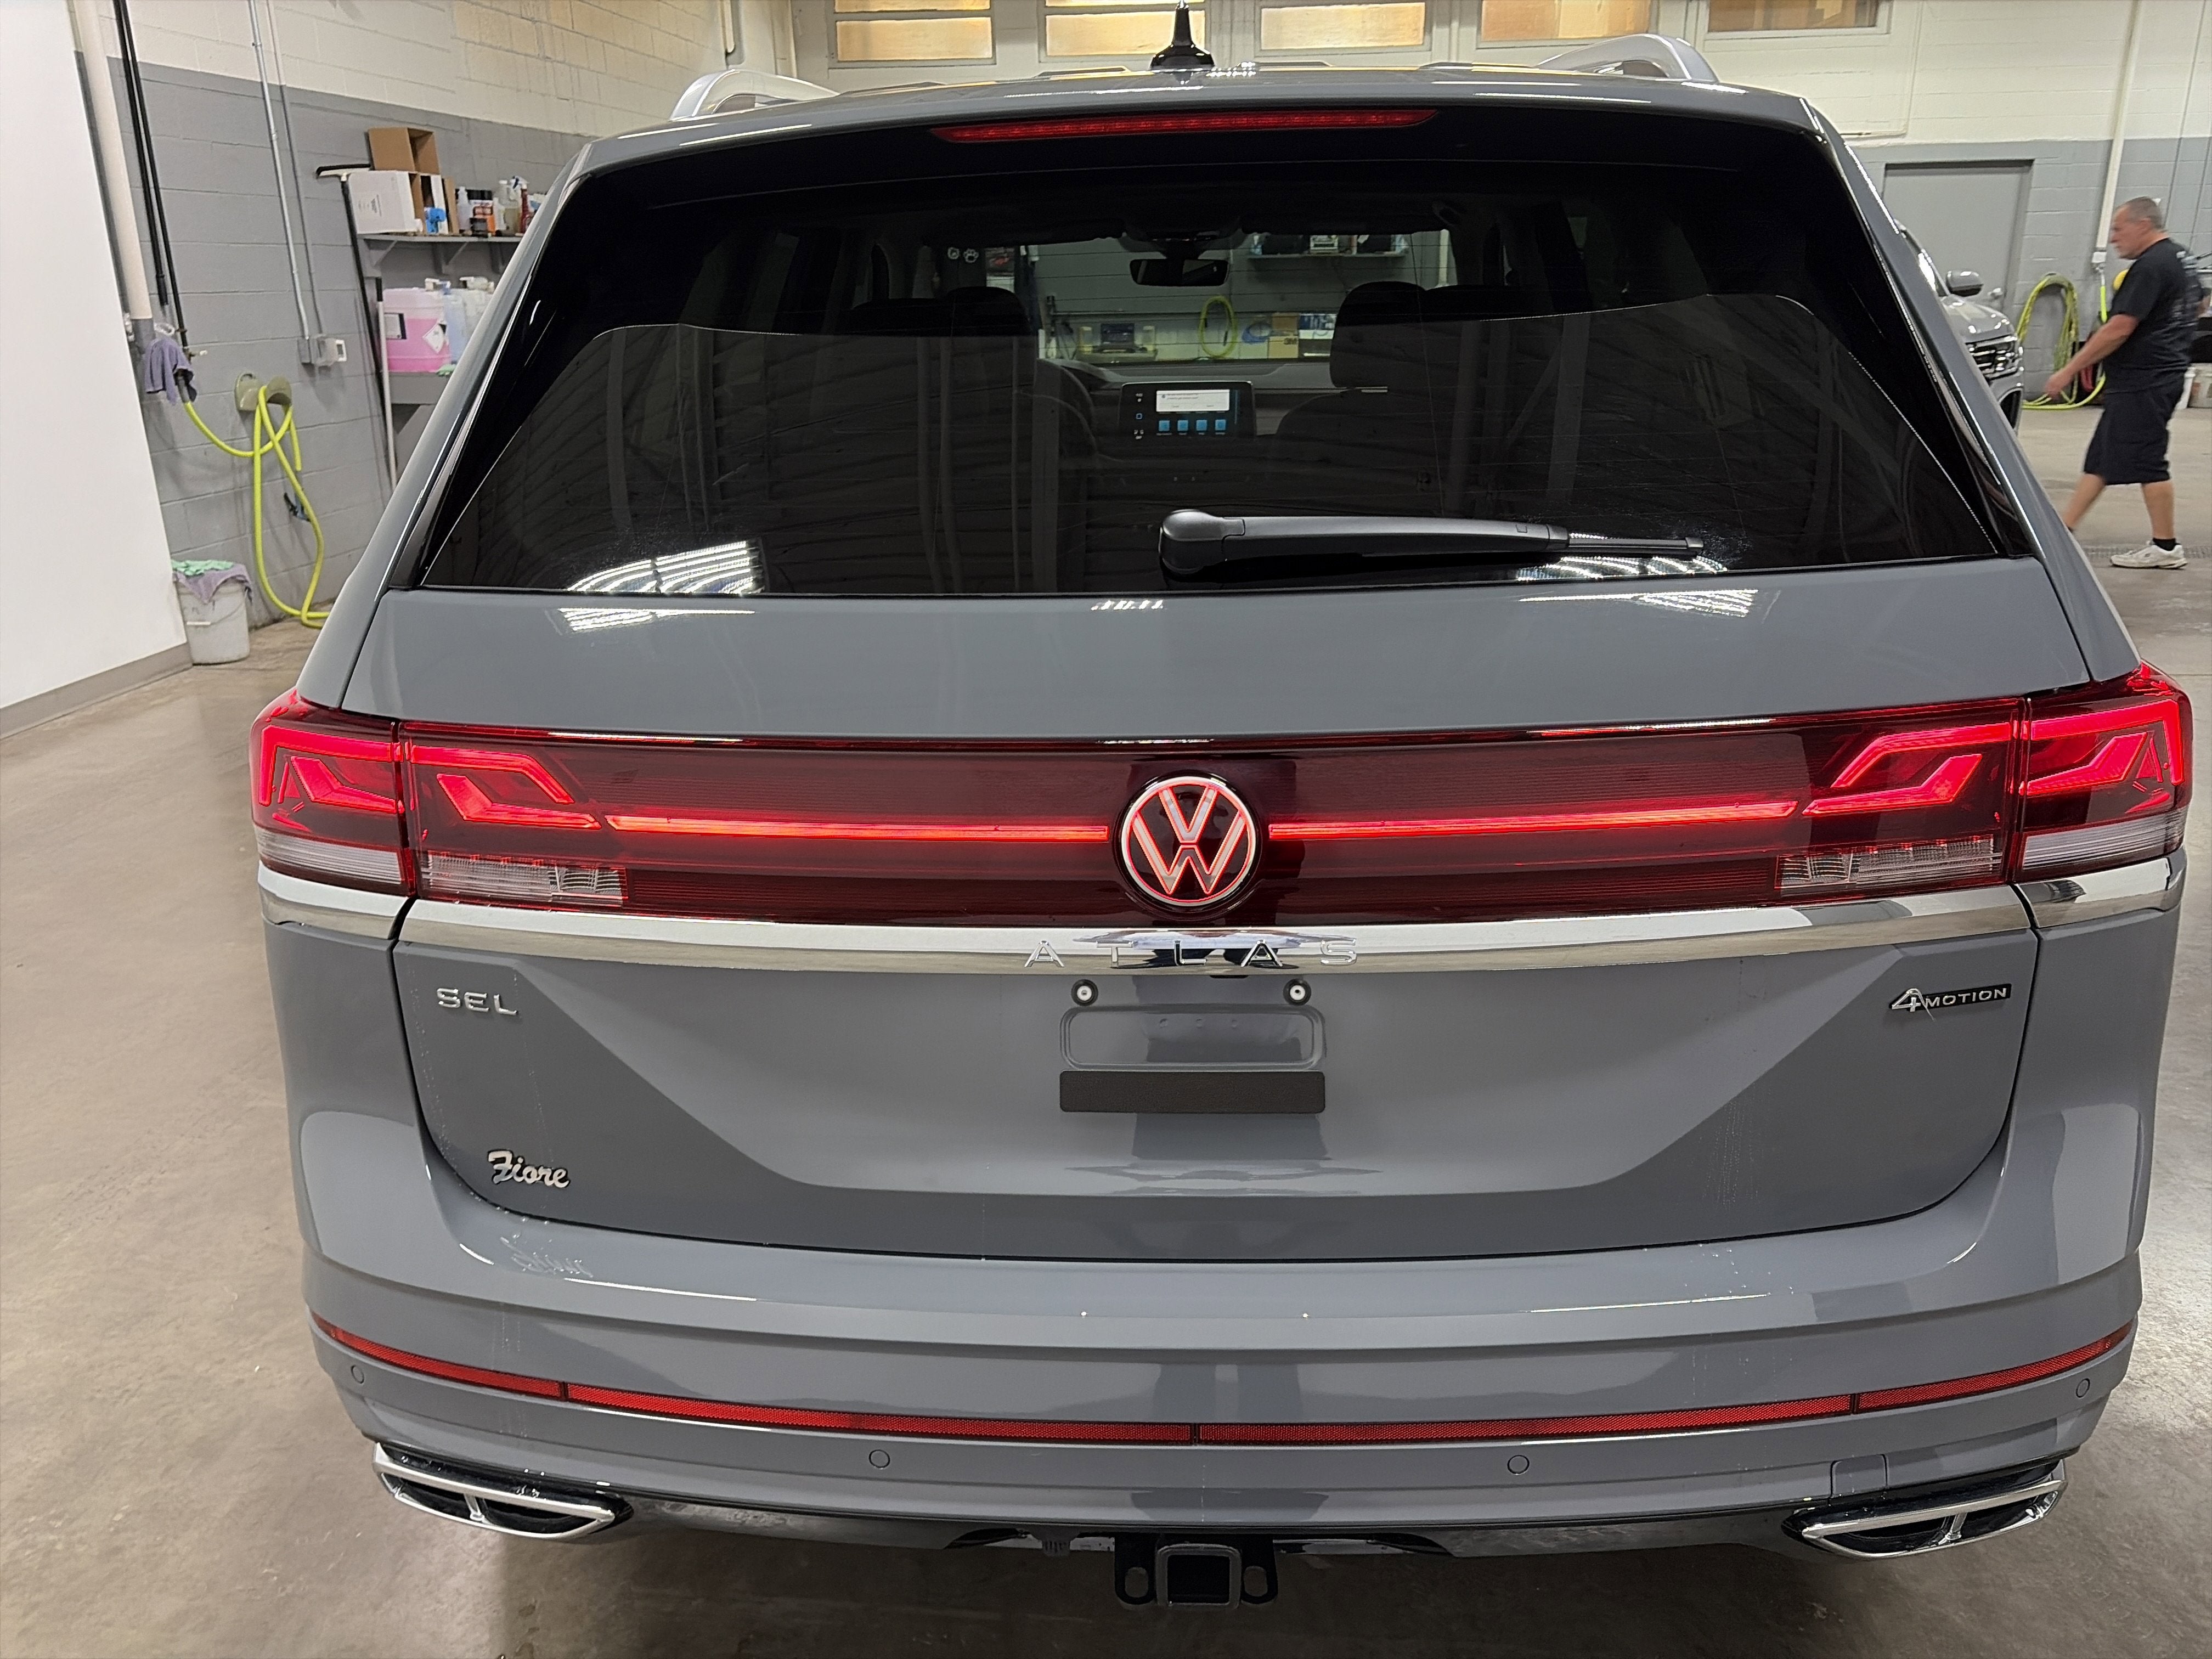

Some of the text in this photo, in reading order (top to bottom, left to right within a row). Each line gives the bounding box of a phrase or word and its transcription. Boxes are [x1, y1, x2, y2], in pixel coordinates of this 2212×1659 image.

[1024, 940, 1357, 968] ATLAS
[437, 988, 518, 1015] SEL
[1892, 988, 2007, 1022] 4MOTION
[488, 1149, 570, 1189] Fiore
